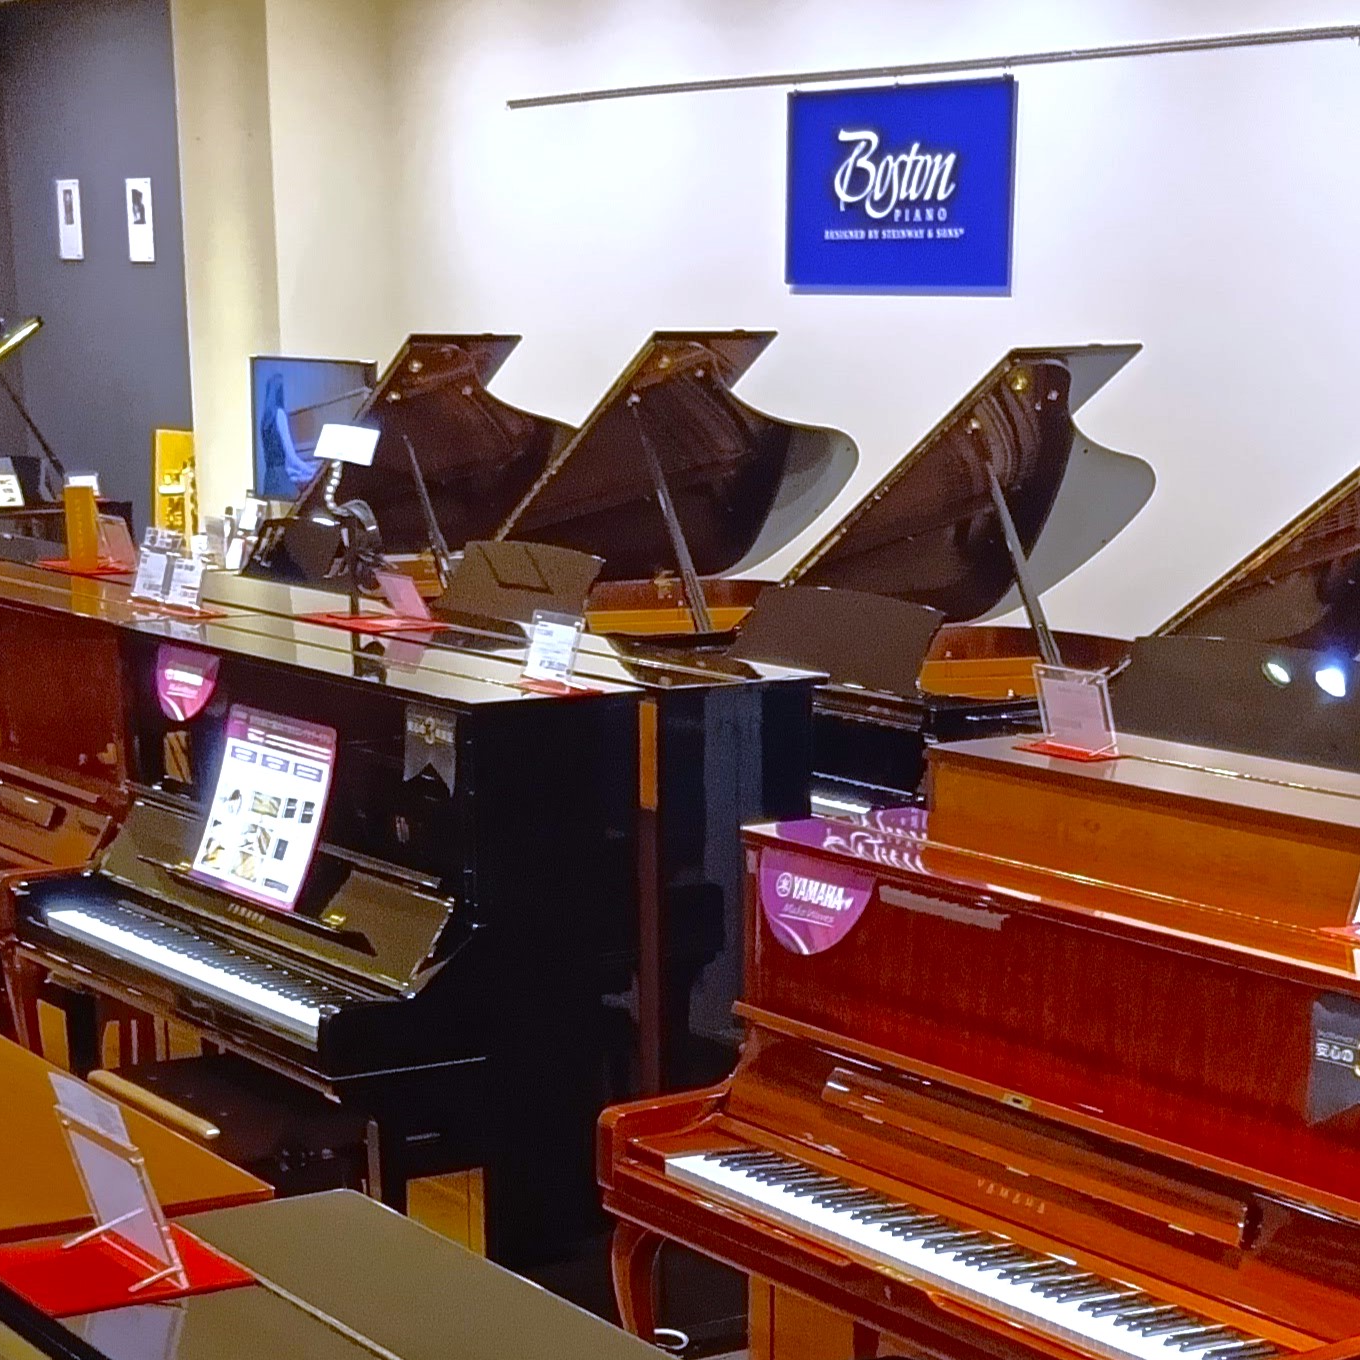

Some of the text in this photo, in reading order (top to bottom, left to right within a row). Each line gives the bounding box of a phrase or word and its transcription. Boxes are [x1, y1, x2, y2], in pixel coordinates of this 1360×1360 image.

[834, 129, 956, 218] Boston
[894, 208, 947, 222] PIANO
[824, 229, 865, 240] DESIGNED
[868, 229, 879, 239] BY
[881, 228, 924, 239] STEINWAY
[792, 876, 845, 911] YAMAHA
